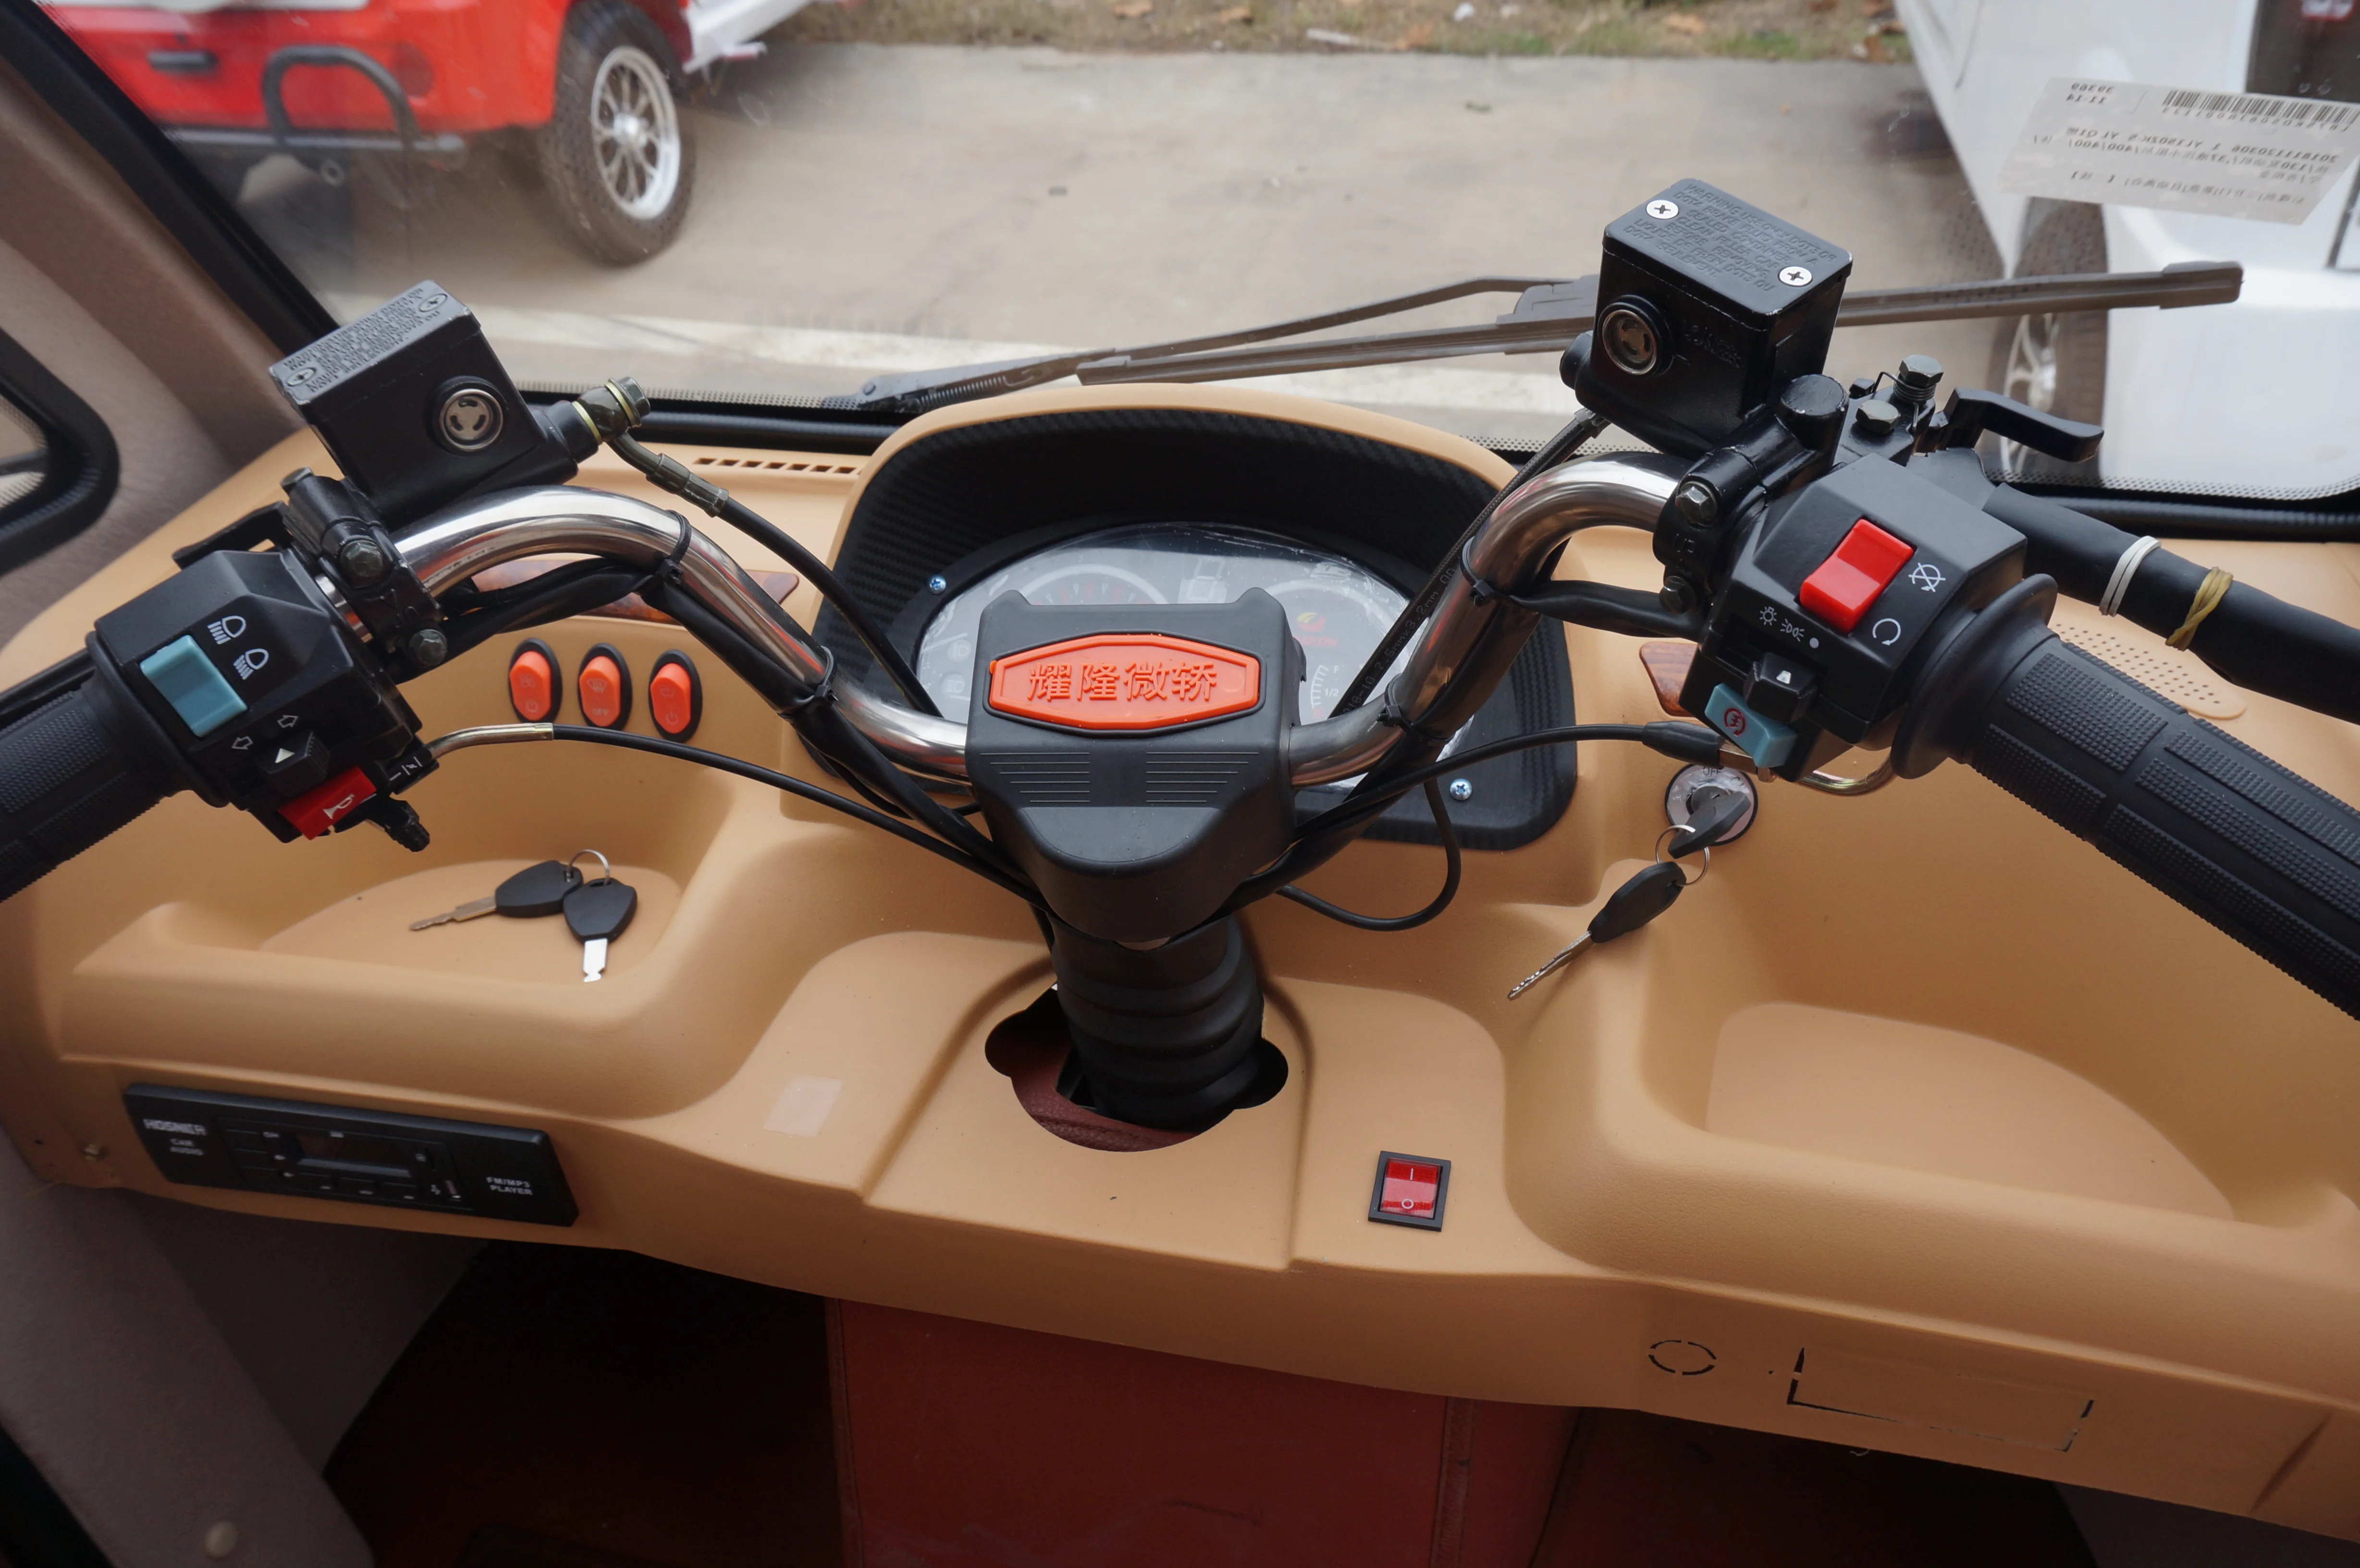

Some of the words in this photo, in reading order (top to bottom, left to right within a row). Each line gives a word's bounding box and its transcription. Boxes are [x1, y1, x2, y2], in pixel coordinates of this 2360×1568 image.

[1682, 184, 1744, 215] WARNING
[1737, 211, 1766, 227] USE
[1684, 209, 1730, 233] SEALED
[1701, 206, 1740, 226] BRAKE
[1738, 223, 1774, 243] FLUID
[1771, 240, 1808, 259] FROM
[1663, 222, 1709, 246] BEFORE
[1672, 238, 1693, 250] DE
[1673, 215, 1714, 237] CLEAN
[1714, 235, 1755, 257] FILLER
[1028, 662, 1217, 701] 耀隆微轿
[1334, 665, 1340, 674] F
[1325, 688, 1340, 697] 1/2
[486, 1176, 530, 1188] FM/MP3
[489, 1185, 532, 1196] PLAYER
